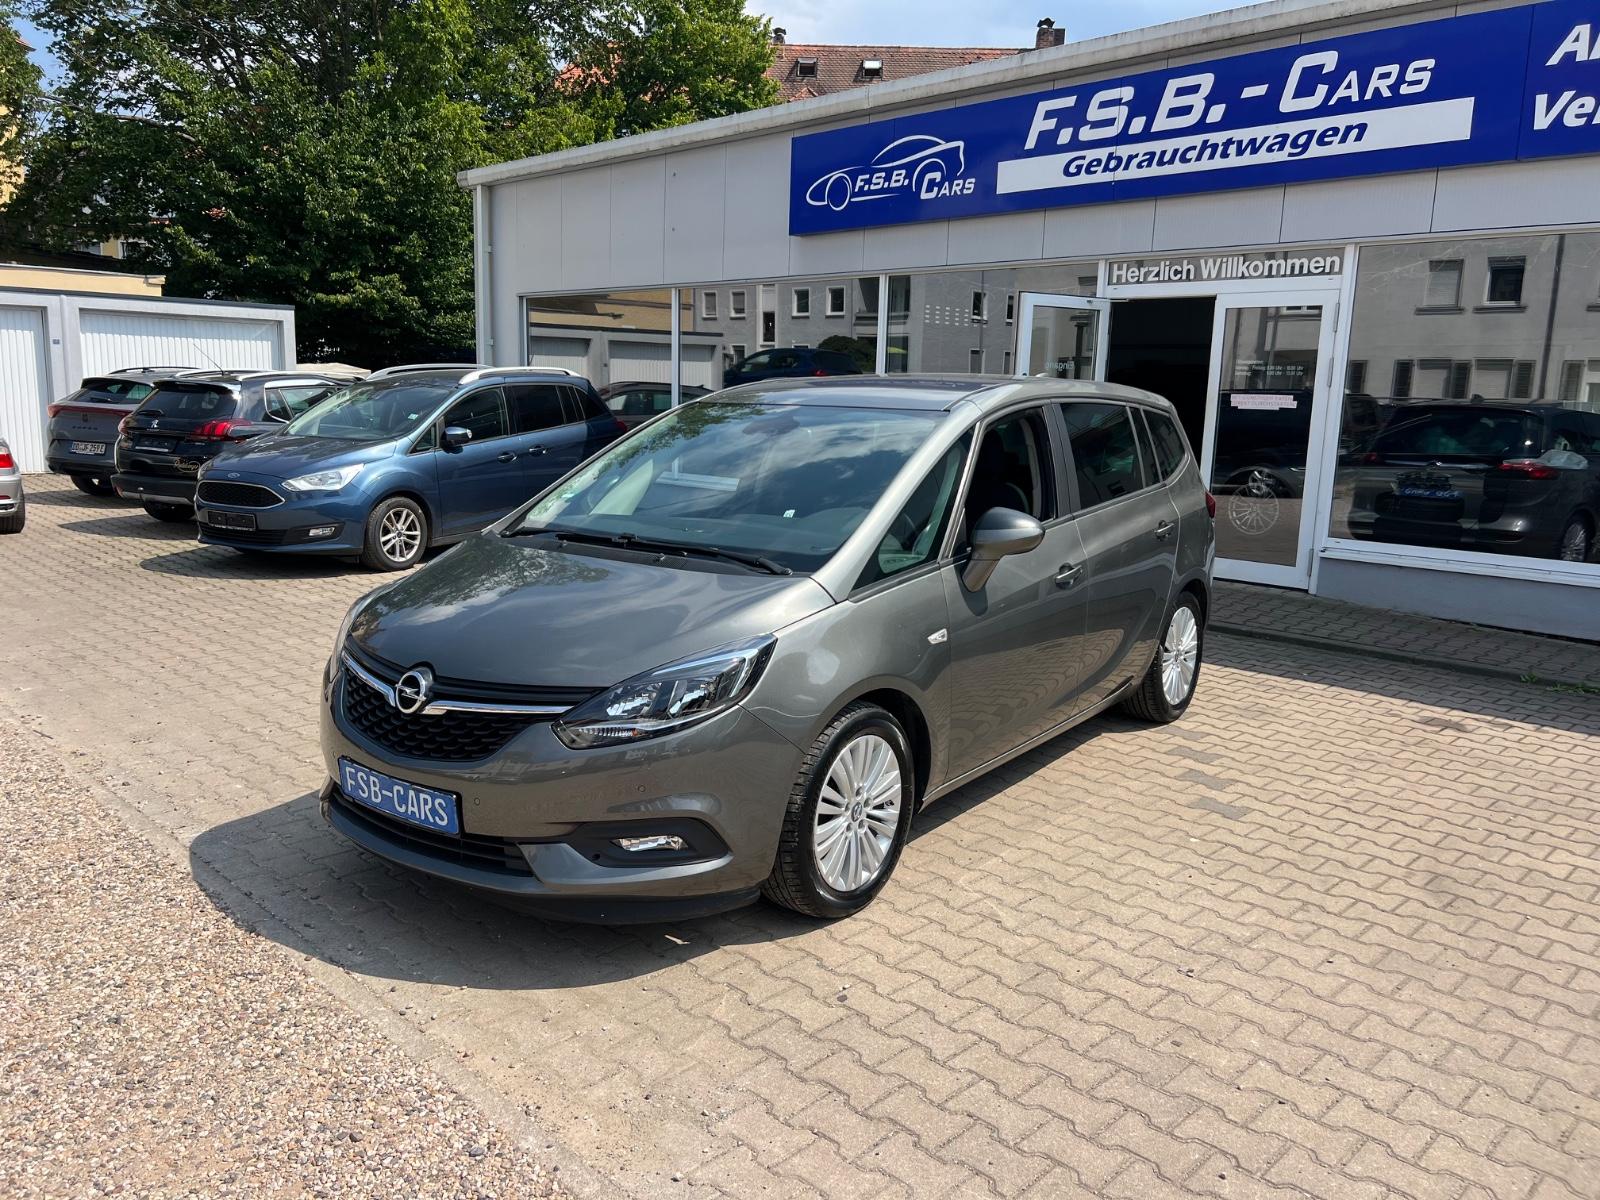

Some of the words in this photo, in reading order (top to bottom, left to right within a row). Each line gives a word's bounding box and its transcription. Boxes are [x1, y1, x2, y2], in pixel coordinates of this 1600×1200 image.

[1545, 23, 1600, 66] A
[1062, 122, 1369, 178] Gebrauchtwagen
[854, 169, 909, 193] F.S.B.
[1112, 260, 1195, 284] Herzlich
[1200, 255, 1341, 280] Willkommen
[345, 765, 449, 827] FSB-CARS
